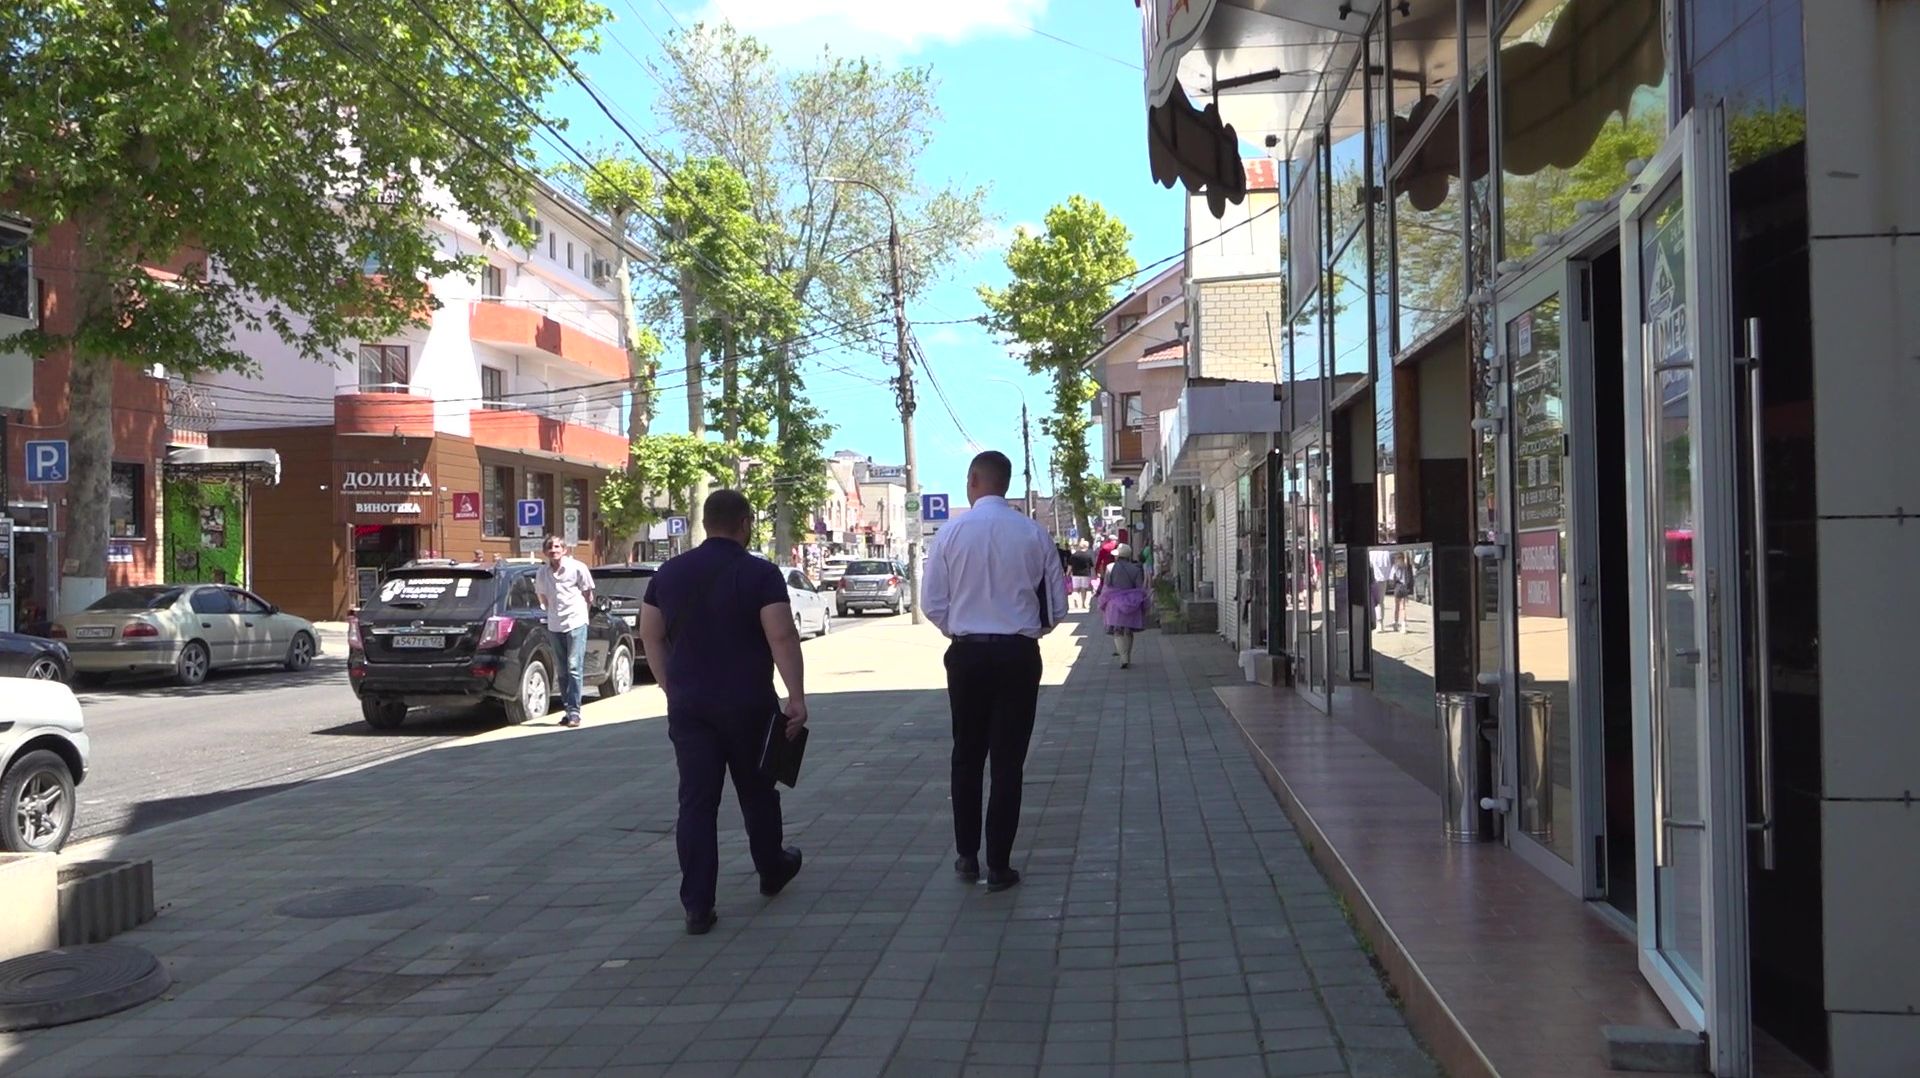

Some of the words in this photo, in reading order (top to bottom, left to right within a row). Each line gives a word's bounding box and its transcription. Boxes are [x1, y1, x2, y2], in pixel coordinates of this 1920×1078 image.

[36, 446, 59, 478] P
[343, 470, 432, 489] ДОЛИНА
[355, 503, 421, 513] ВИНОТЕКА
[524, 503, 539, 524] P
[930, 497, 945, 518] P
[672, 519, 682, 533] P
